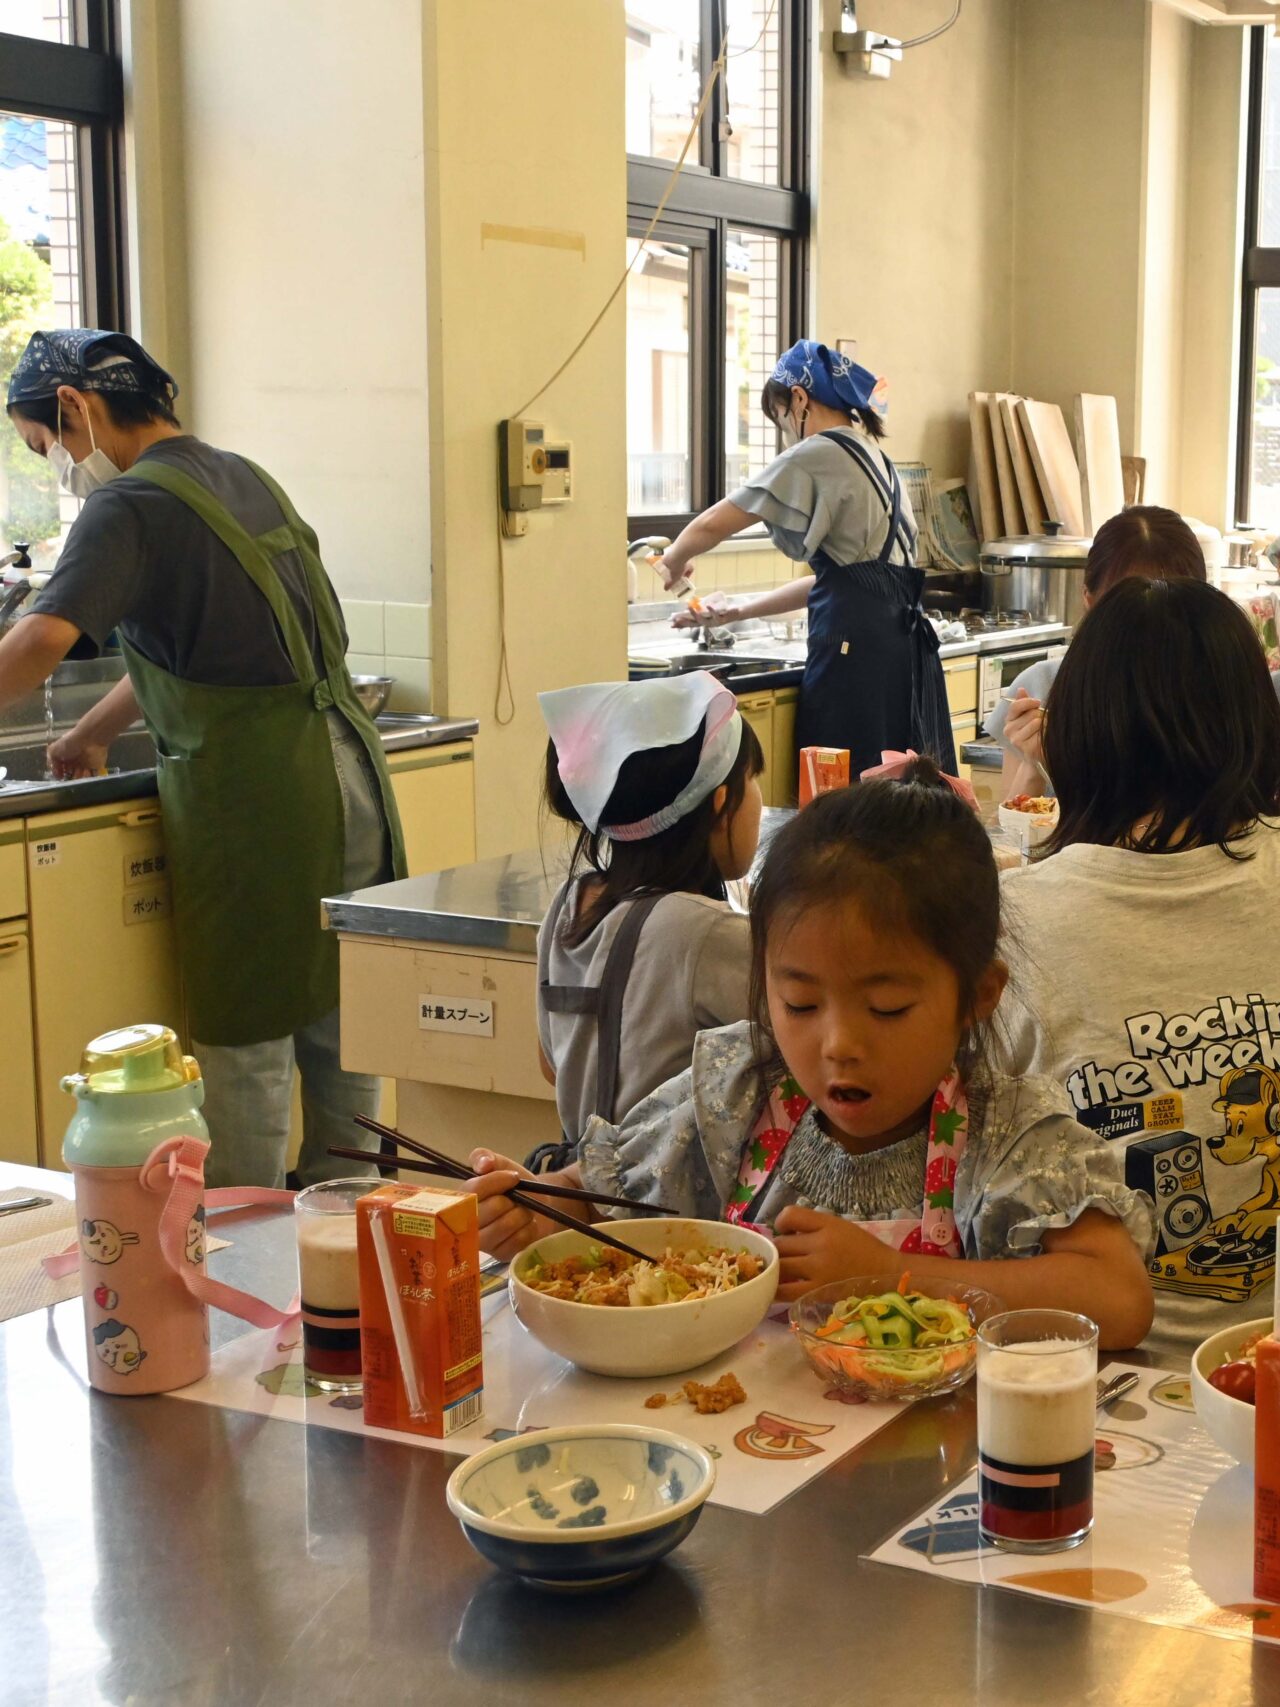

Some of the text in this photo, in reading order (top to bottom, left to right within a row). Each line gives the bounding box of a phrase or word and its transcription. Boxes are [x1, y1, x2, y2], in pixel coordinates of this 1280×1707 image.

[37, 842, 57, 853] 炊飯器
[37, 856, 56, 866] ポット
[130, 855, 166, 877] 炊飯器
[133, 897, 163, 915] ポット
[421, 1004, 490, 1023] 計量スプーン
[1067, 1061, 1152, 1110] the
[1151, 1098, 1175, 1107] KEEP
[1151, 1104, 1175, 1113] CALM
[1110, 1106, 1138, 1120] Duet
[1153, 1111, 1175, 1120] STAY
[1092, 1117, 1139, 1137] riginals
[1147, 1117, 1181, 1128] GROOVY
[936, 1507, 978, 1519] ILK
